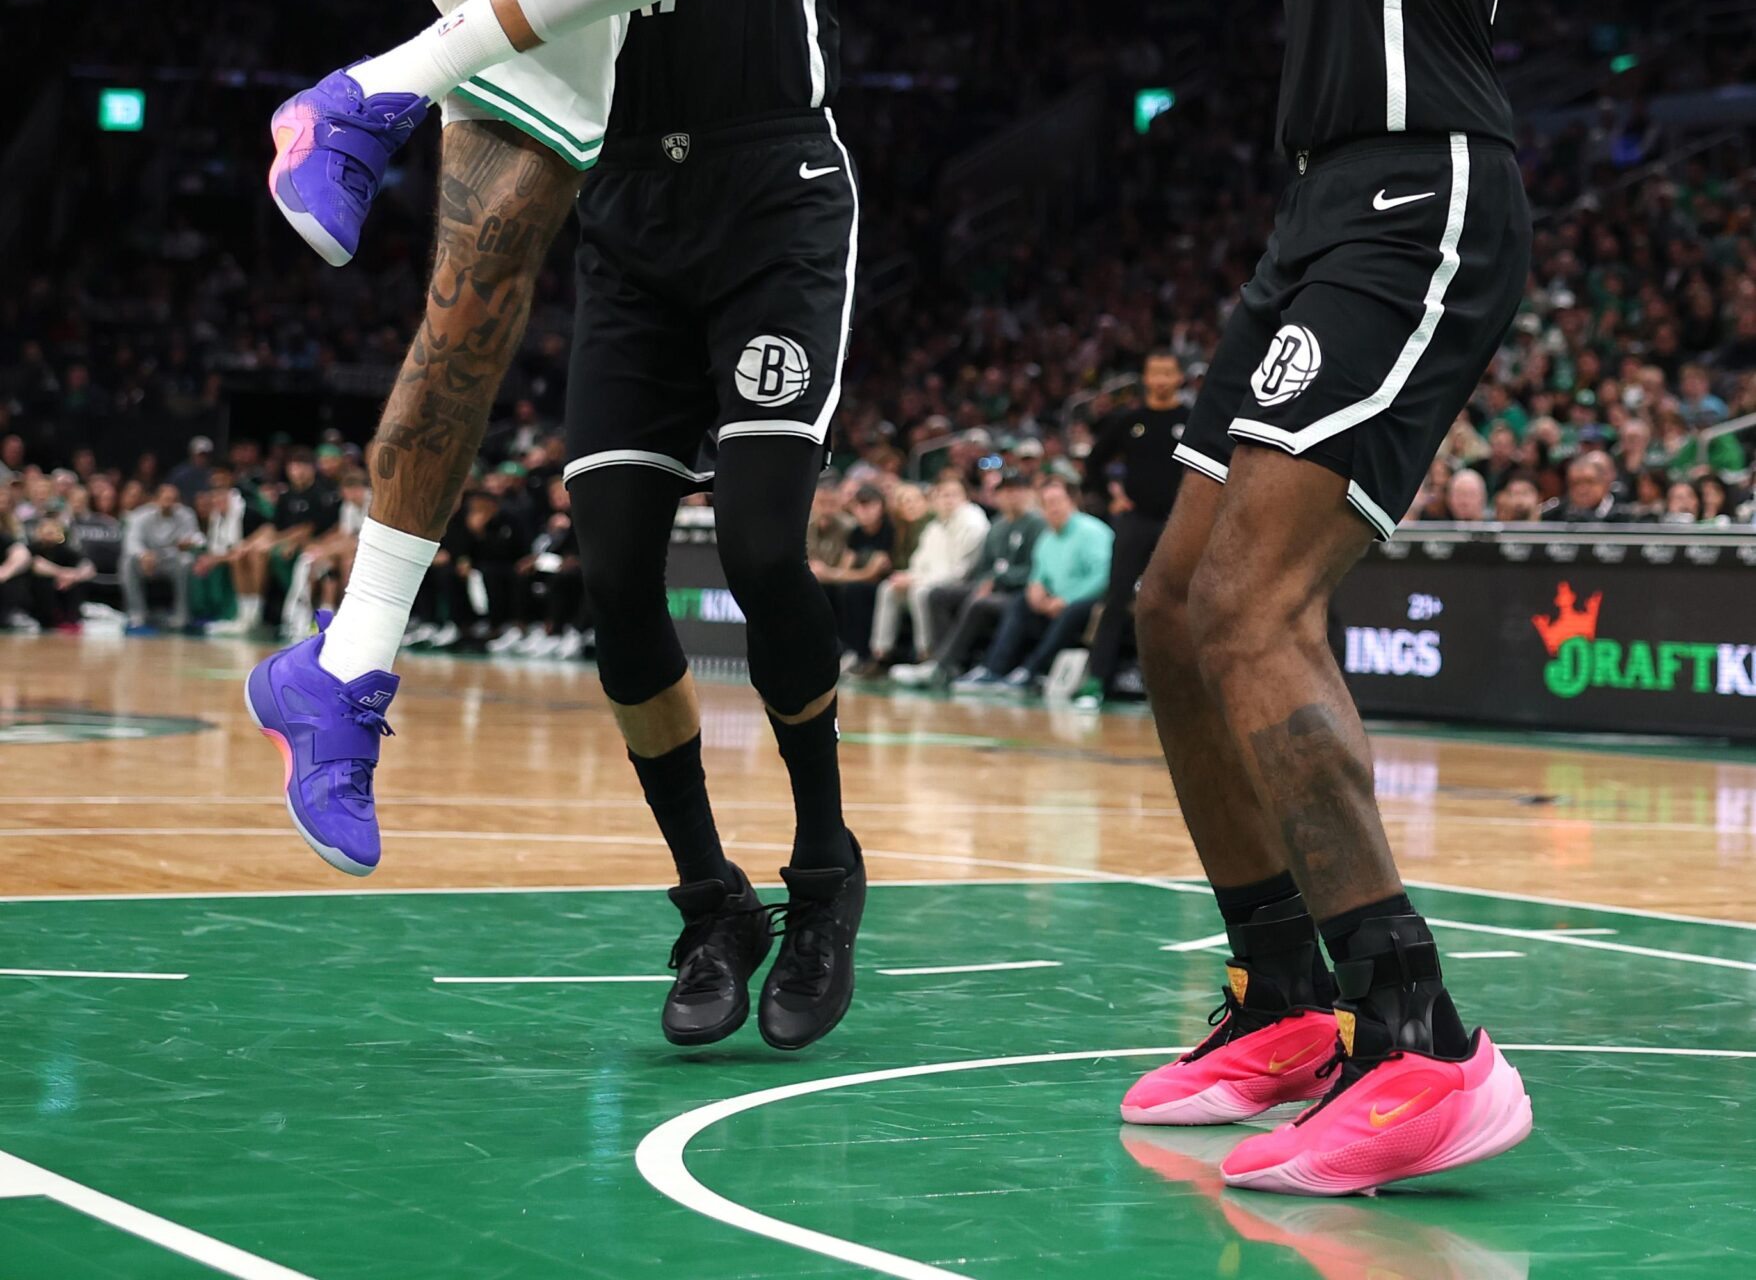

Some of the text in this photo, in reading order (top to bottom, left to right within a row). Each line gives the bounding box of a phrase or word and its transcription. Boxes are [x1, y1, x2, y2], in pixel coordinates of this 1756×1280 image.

[664, 135, 688, 150] NETS
[757, 343, 786, 396] B
[1344, 625, 1443, 679] INGS
